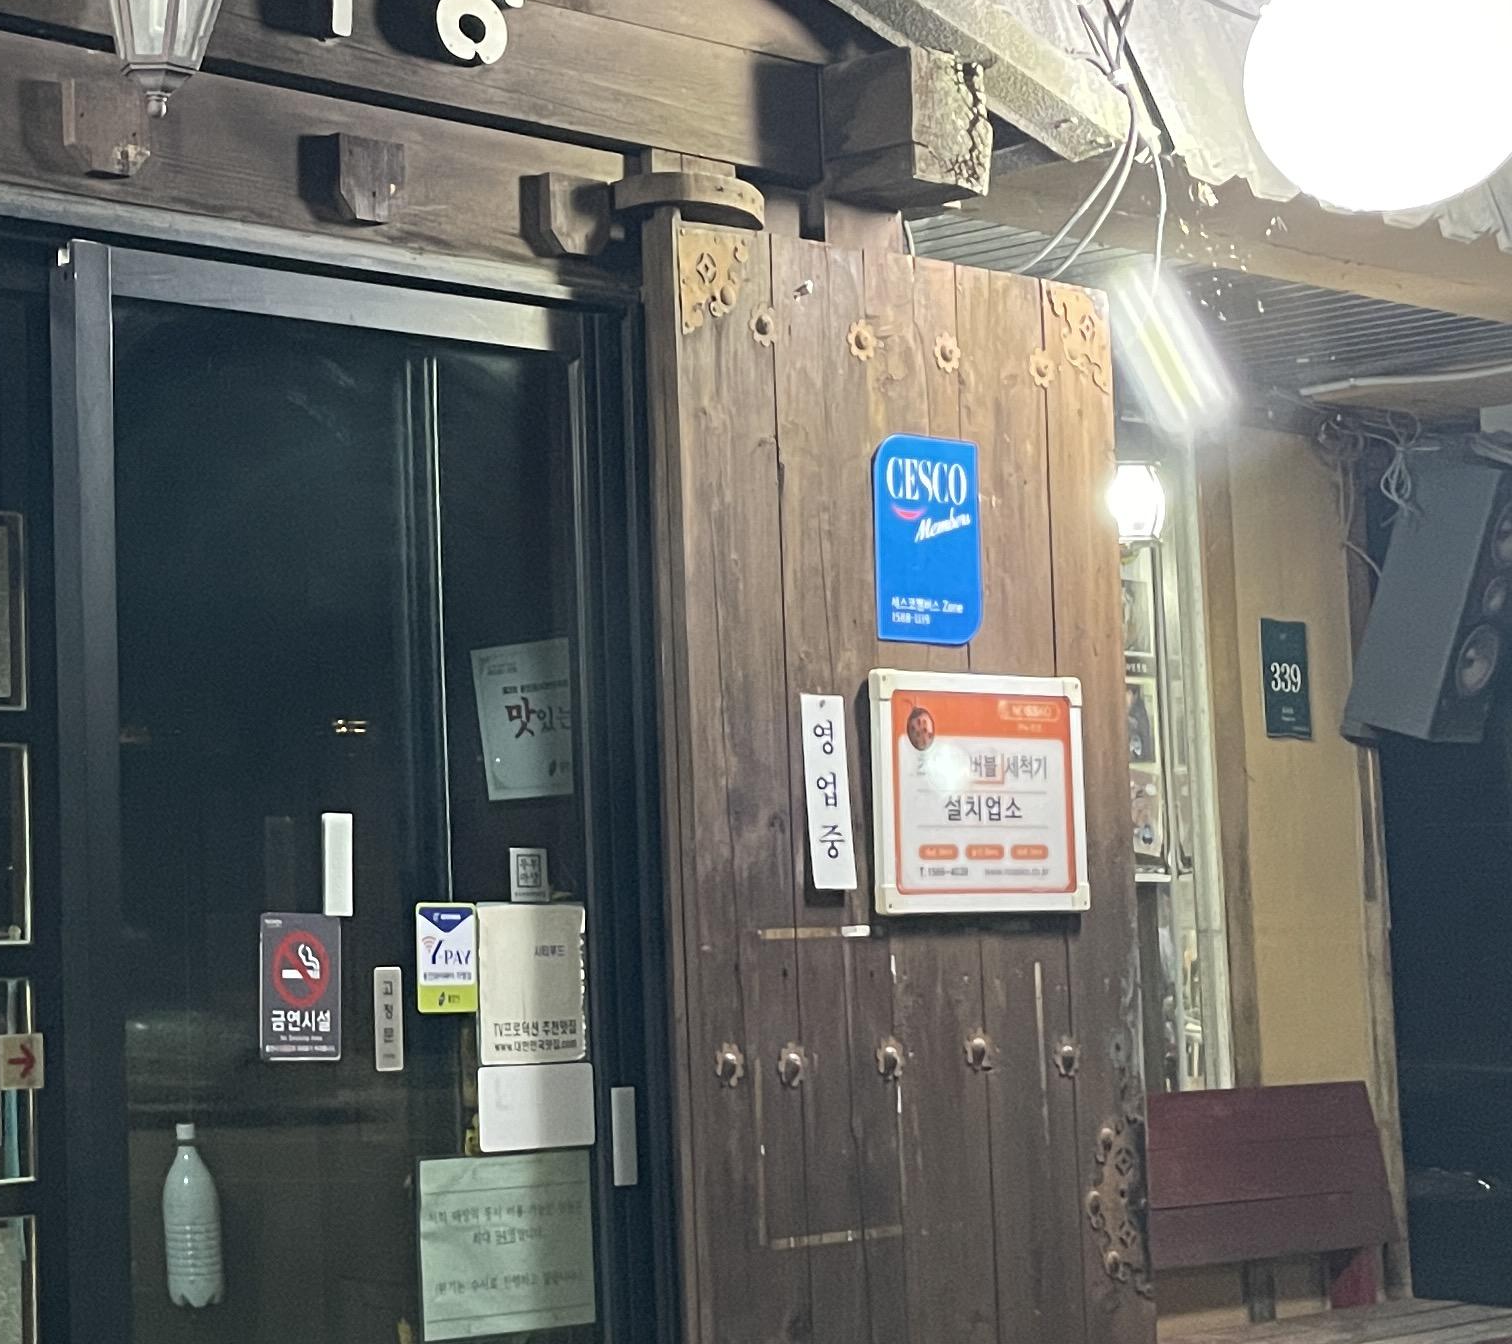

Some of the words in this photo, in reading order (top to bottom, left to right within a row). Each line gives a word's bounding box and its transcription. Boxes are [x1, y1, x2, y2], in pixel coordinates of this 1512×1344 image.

[886, 456, 968, 505] CESCO
[942, 599, 964, 614] Zone
[1270, 662, 1302, 693] 339
[1004, 754, 1048, 780] 세척기
[813, 719, 846, 859] 영업중
[944, 795, 1024, 823] 설치업소
[271, 1009, 331, 1032] 금연시설
